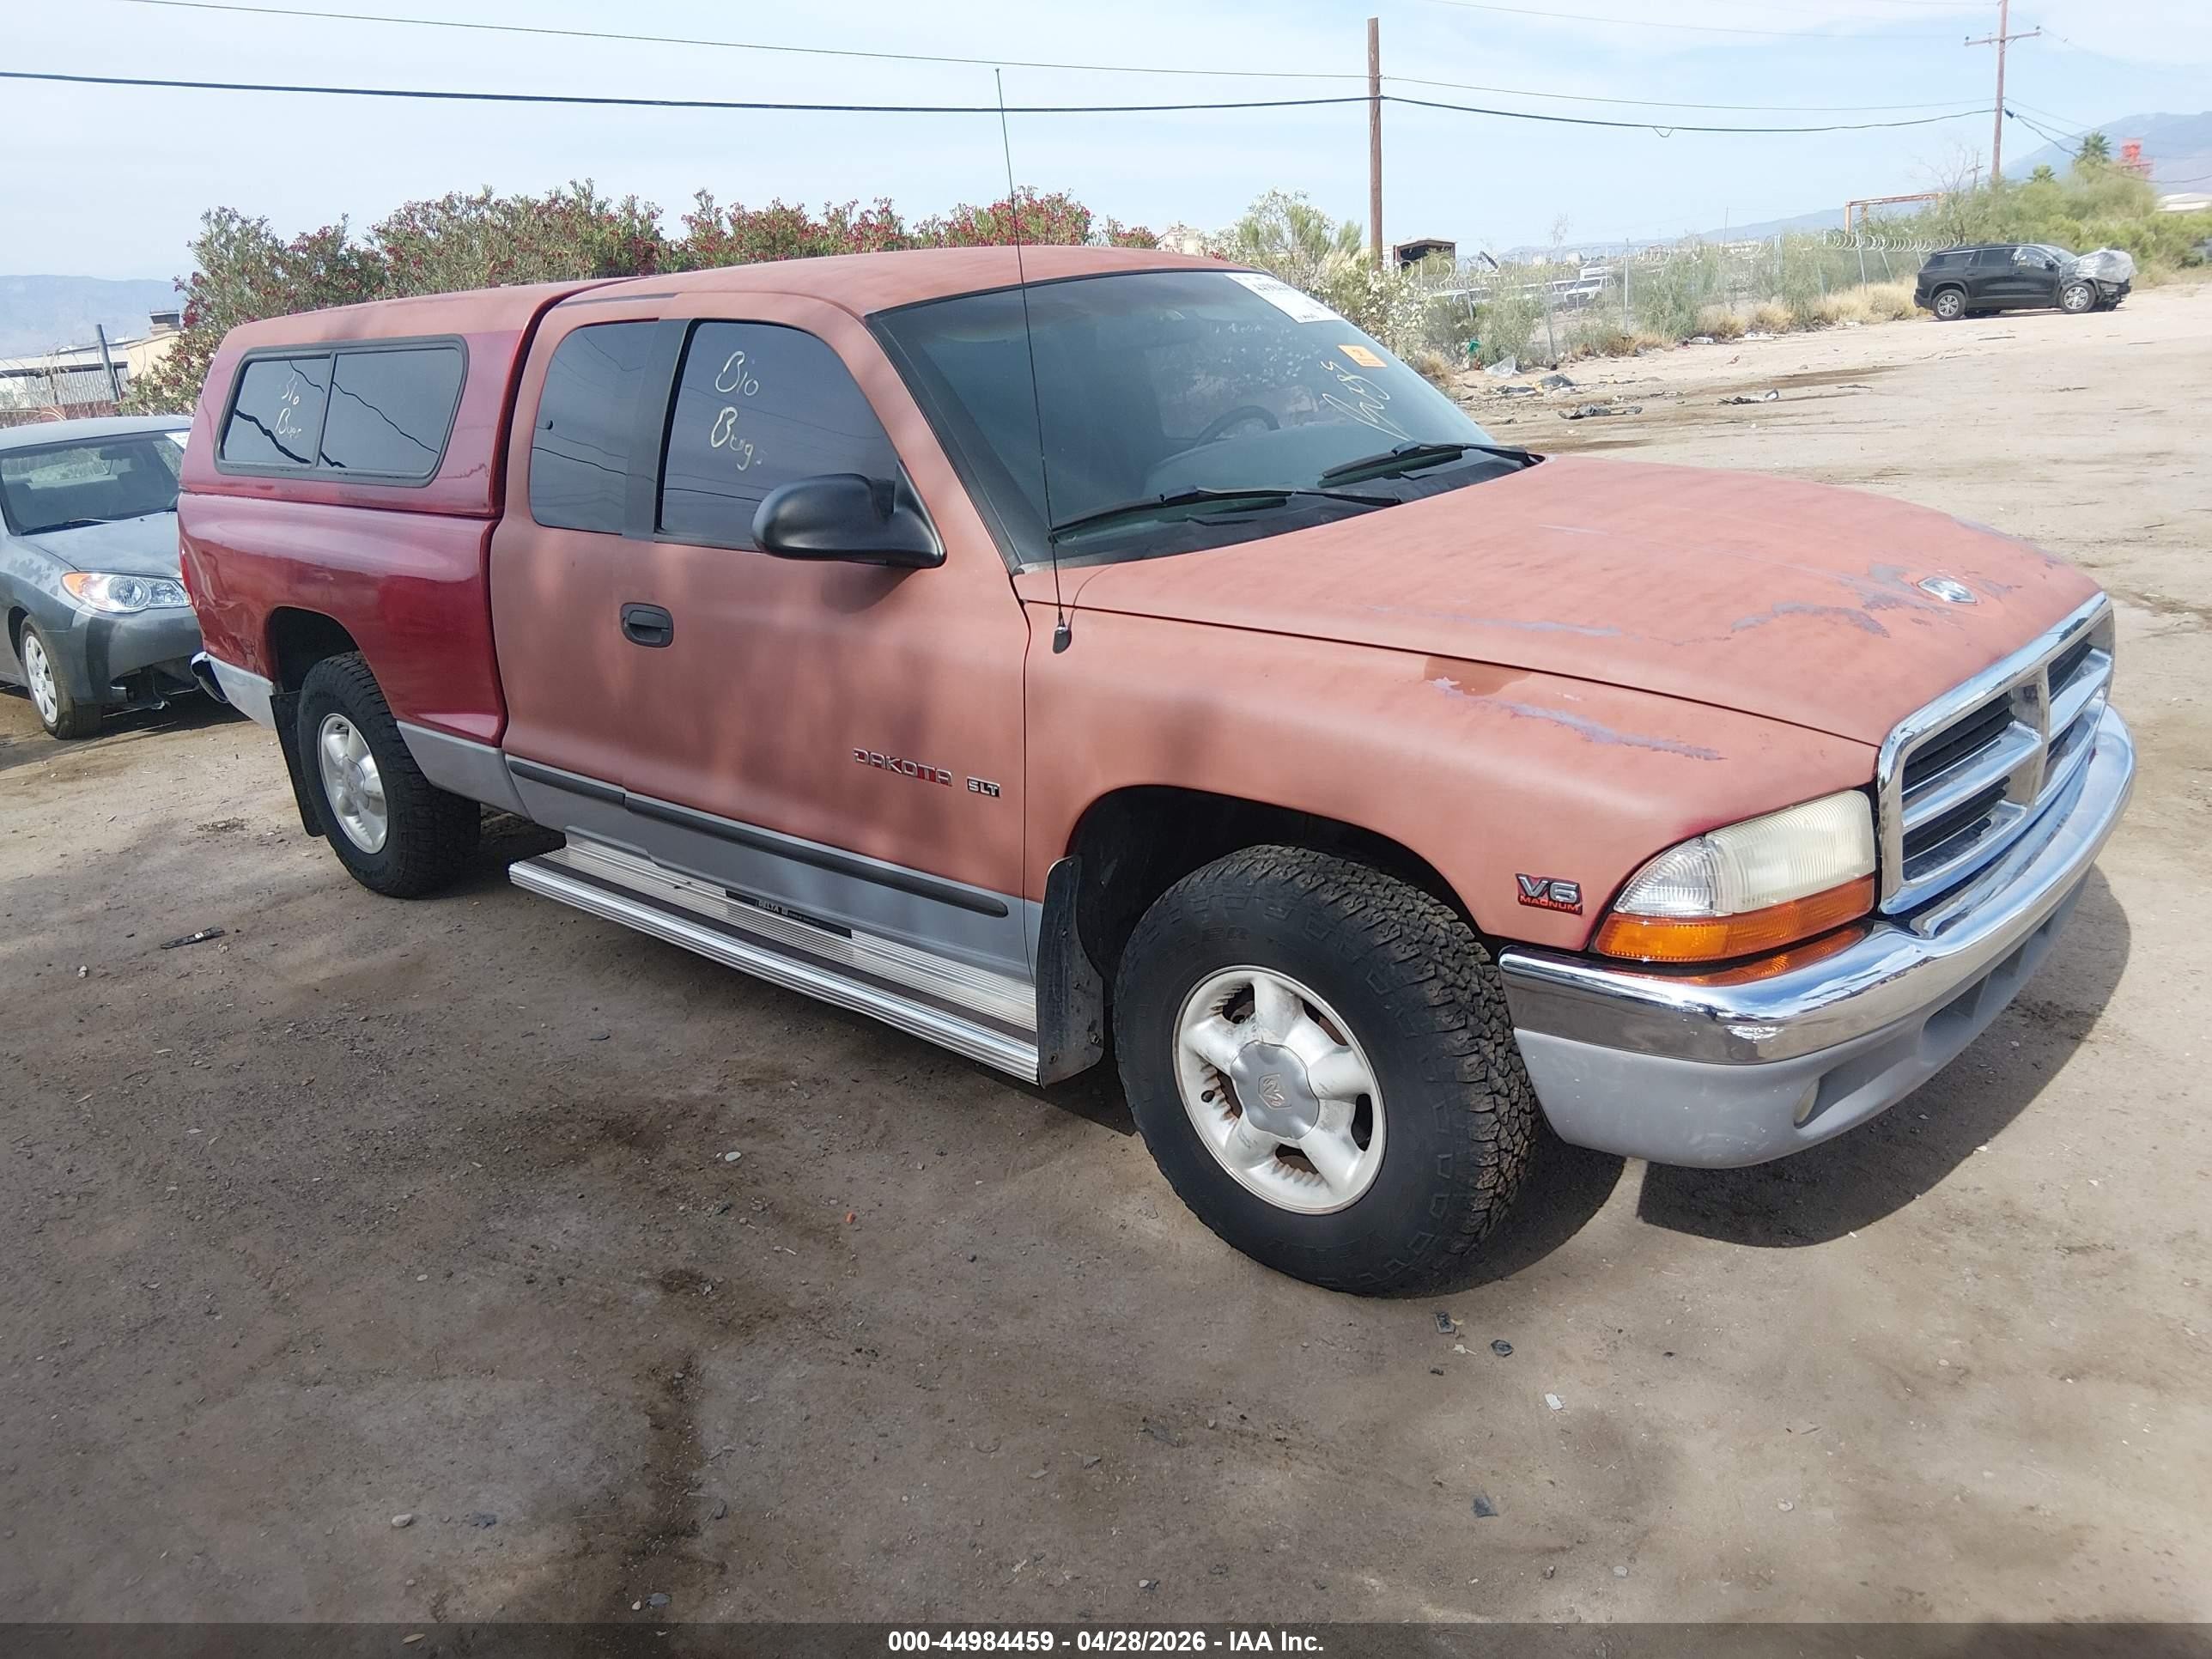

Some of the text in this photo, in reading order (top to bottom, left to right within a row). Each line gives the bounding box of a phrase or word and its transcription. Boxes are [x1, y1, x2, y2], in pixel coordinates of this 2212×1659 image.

[715, 350, 759, 396] Bio
[853, 748, 1000, 797] DAKOTA SLT
[1517, 875, 1578, 903] V6
[1519, 895, 1579, 911] MAGNUM
